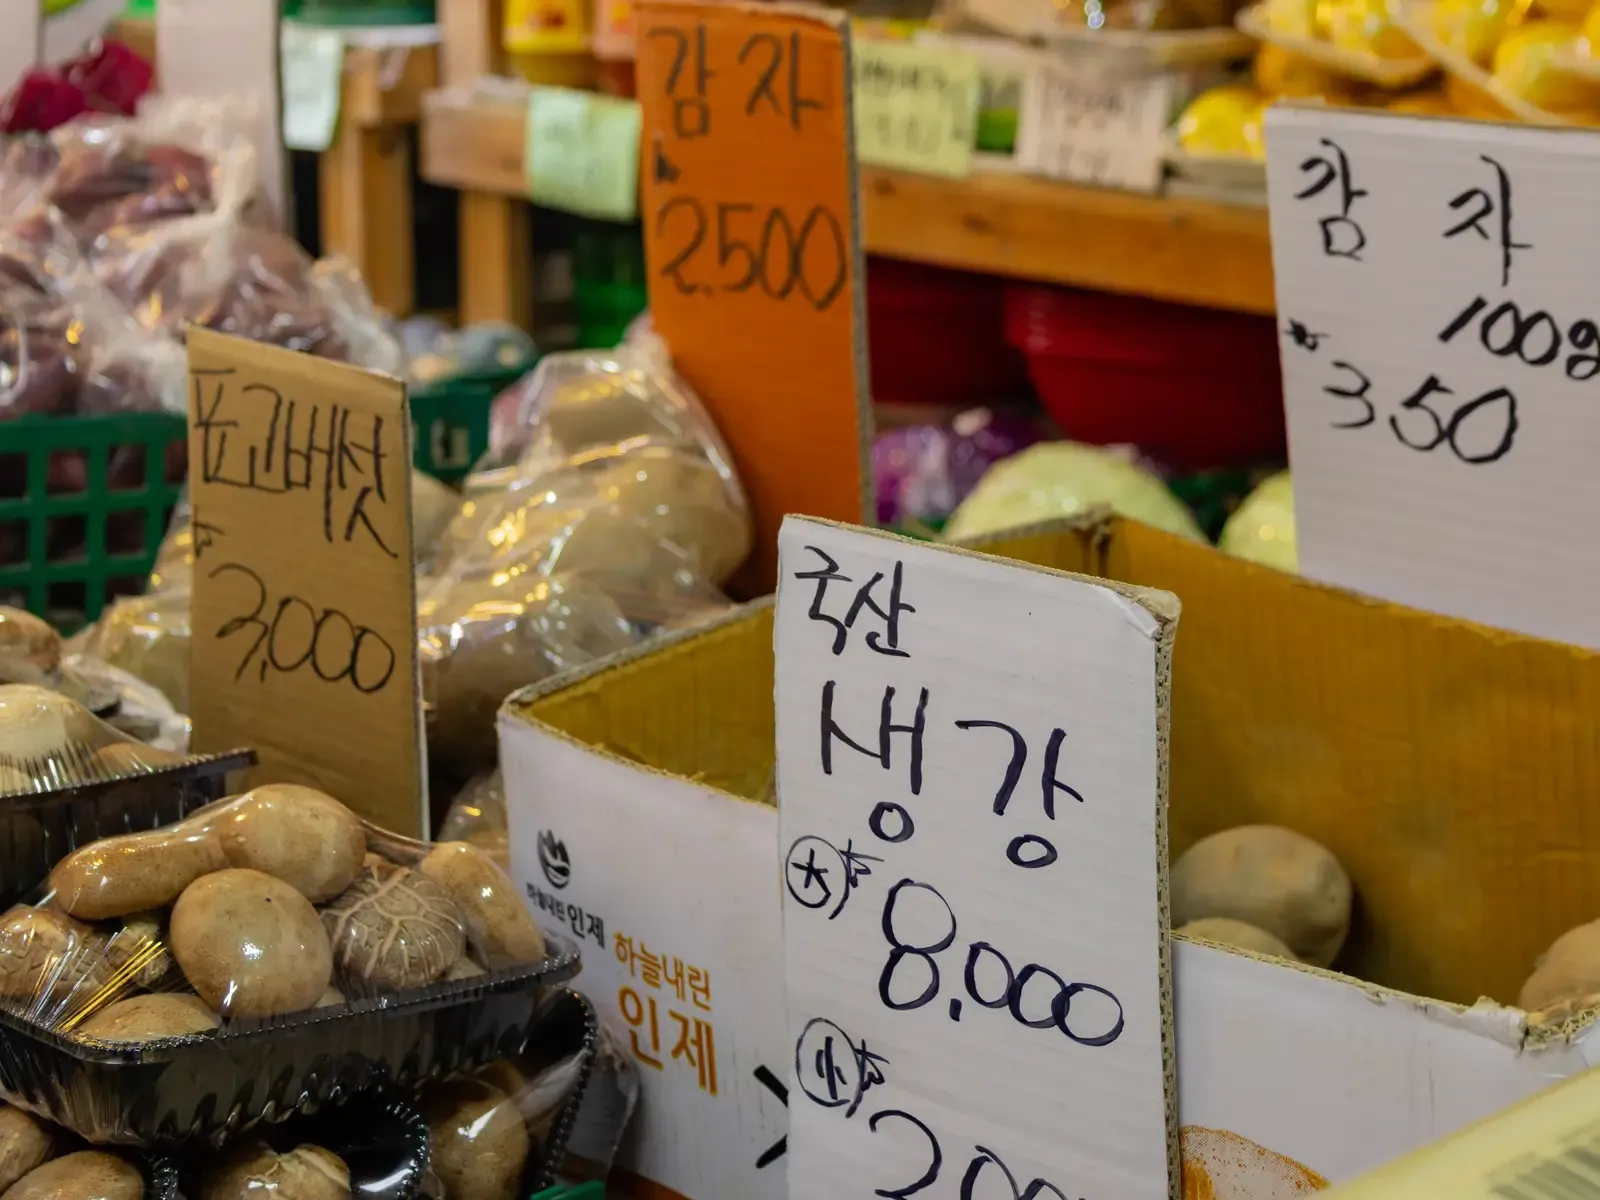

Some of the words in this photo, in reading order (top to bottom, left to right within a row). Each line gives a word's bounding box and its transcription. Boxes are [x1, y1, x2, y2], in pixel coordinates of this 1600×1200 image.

[188, 367, 399, 560] 표고버섯
[1321, 360, 1519, 465] 350
[794, 545, 917, 658] 국산
[566, 903, 606, 951] 인제
[612, 931, 712, 1012] 하늘내린
[617, 985, 719, 1098] 인제
